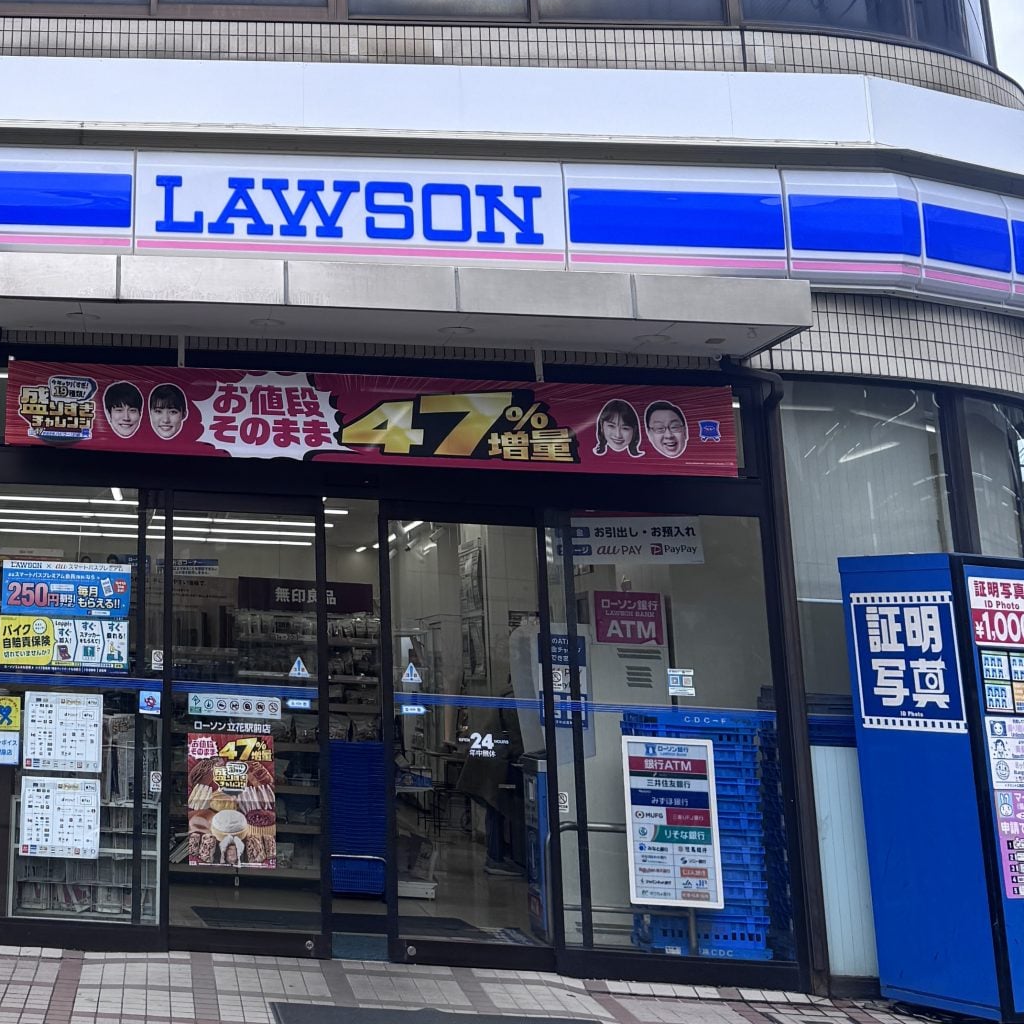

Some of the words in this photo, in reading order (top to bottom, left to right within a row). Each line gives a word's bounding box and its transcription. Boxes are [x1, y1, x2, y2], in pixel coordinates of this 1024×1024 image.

[155, 174, 545, 246] LAWSON
[213, 383, 327, 418] お値段
[31, 414, 91, 429] チャレンジ
[208, 417, 332, 449] そのまま
[487, 428, 574, 462] 増量
[597, 545, 621, 555] au
[621, 545, 642, 555] PAY
[664, 544, 697, 555] PayPay
[77, 585, 98, 598] 毎月
[973, 580, 1024, 600] 証明写真
[601, 598, 658, 611] ローソン銀行
[984, 600, 994, 608] ID
[995, 601, 1020, 610] Photo
[3, 624, 31, 636] バイク
[606, 619, 656, 639] ATM
[865, 605, 943, 653] 証明
[975, 611, 1024, 643] ¥1,00
[2, 635, 51, 649] 自賠責保険
[871, 655, 951, 709] 写真
[469, 732, 495, 750] 24
[644, 759, 692, 771] 銀行ATM
[647, 779, 691, 789] 三井住友銀行
[651, 796, 689, 807] みずほ銀行
[664, 829, 705, 841] りそな銀行
